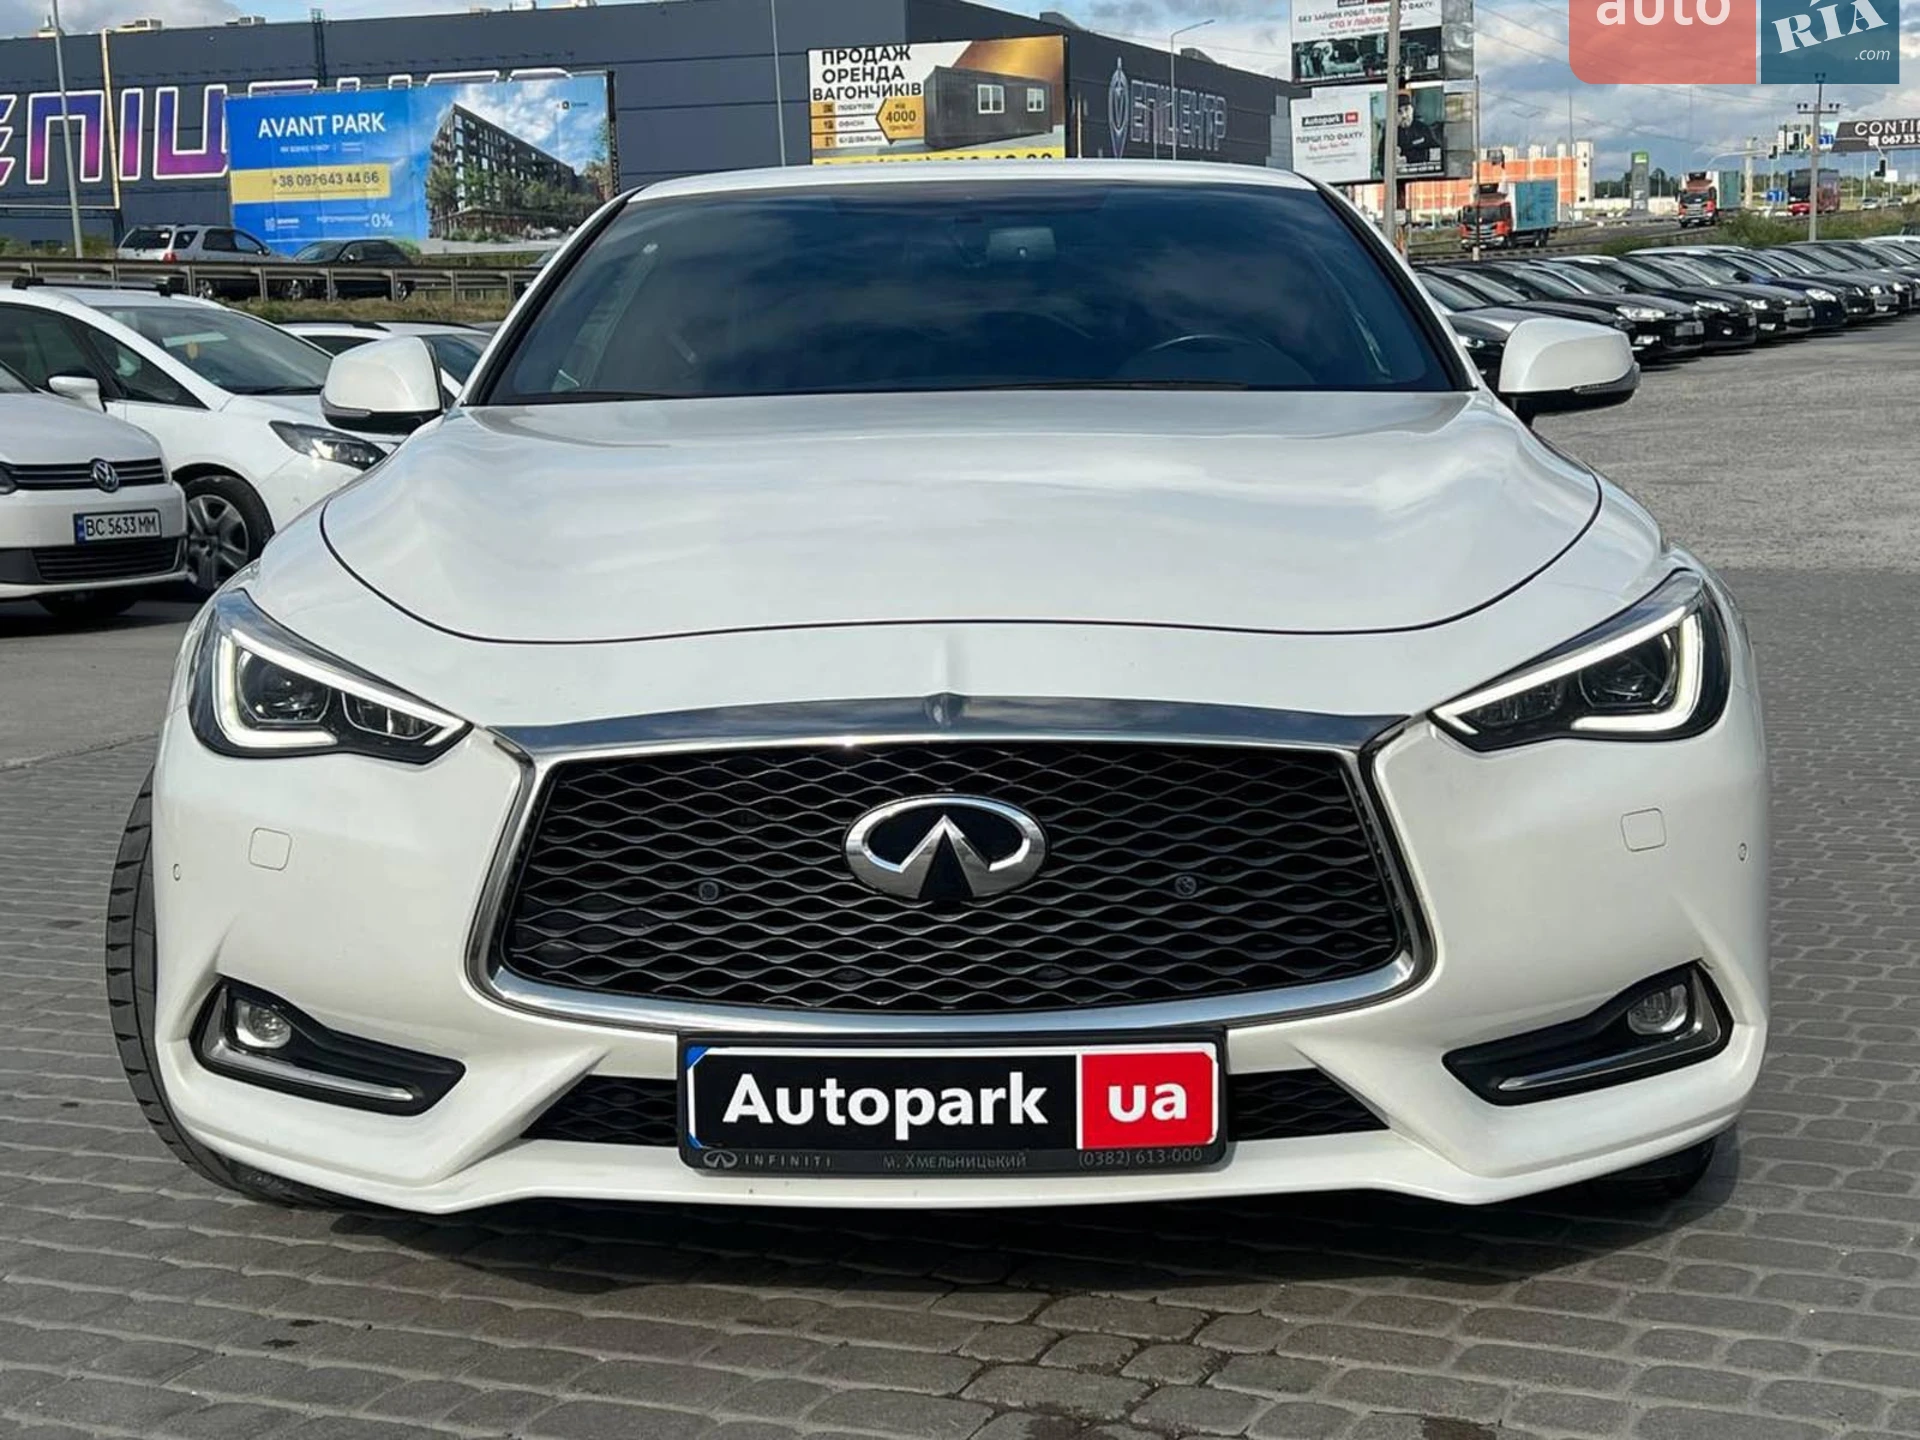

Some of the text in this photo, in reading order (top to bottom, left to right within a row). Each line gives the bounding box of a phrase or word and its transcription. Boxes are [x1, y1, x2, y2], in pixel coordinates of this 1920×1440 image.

[822, 46, 911, 65] ПРОДАЖ
[822, 66, 905, 84] ОРЕНДА
[813, 82, 922, 101] ВАГОНЧИКІВ
[258, 112, 386, 138] AVANT PARK
[885, 110, 916, 123] 4000
[1855, 119, 1920, 136] CONTI
[1881, 134, 1901, 145] 067
[371, 213, 394, 228] 0%
[85, 515, 157, 537] BC 5633 MM
[722, 1071, 1187, 1140] Autopark ua
[745, 1154, 831, 1167] INFINITI
[1079, 1150, 1130, 1169] (0382)
